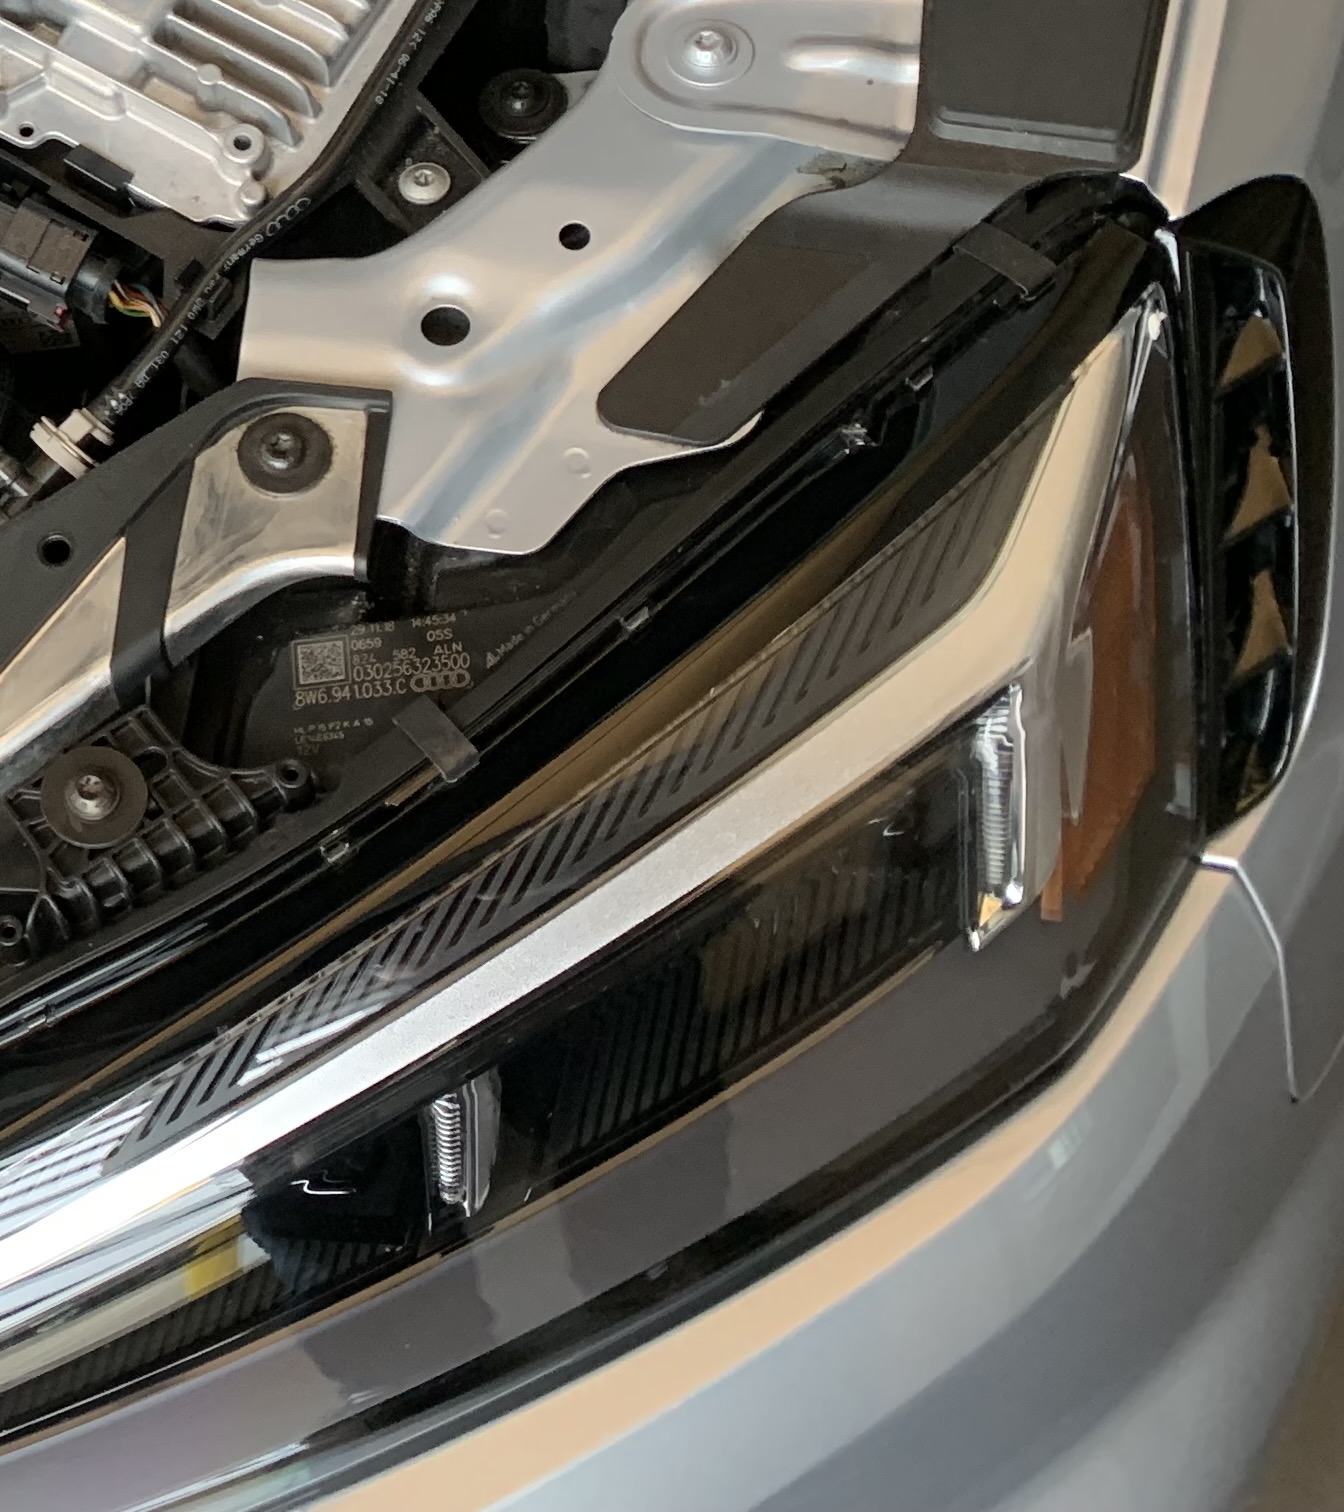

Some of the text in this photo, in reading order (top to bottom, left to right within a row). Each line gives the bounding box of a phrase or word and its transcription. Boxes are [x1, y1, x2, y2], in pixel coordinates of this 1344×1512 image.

[223, 233, 264, 273] Germany
[433, 641, 462, 656] ALN
[353, 652, 471, 682] 030256323500
